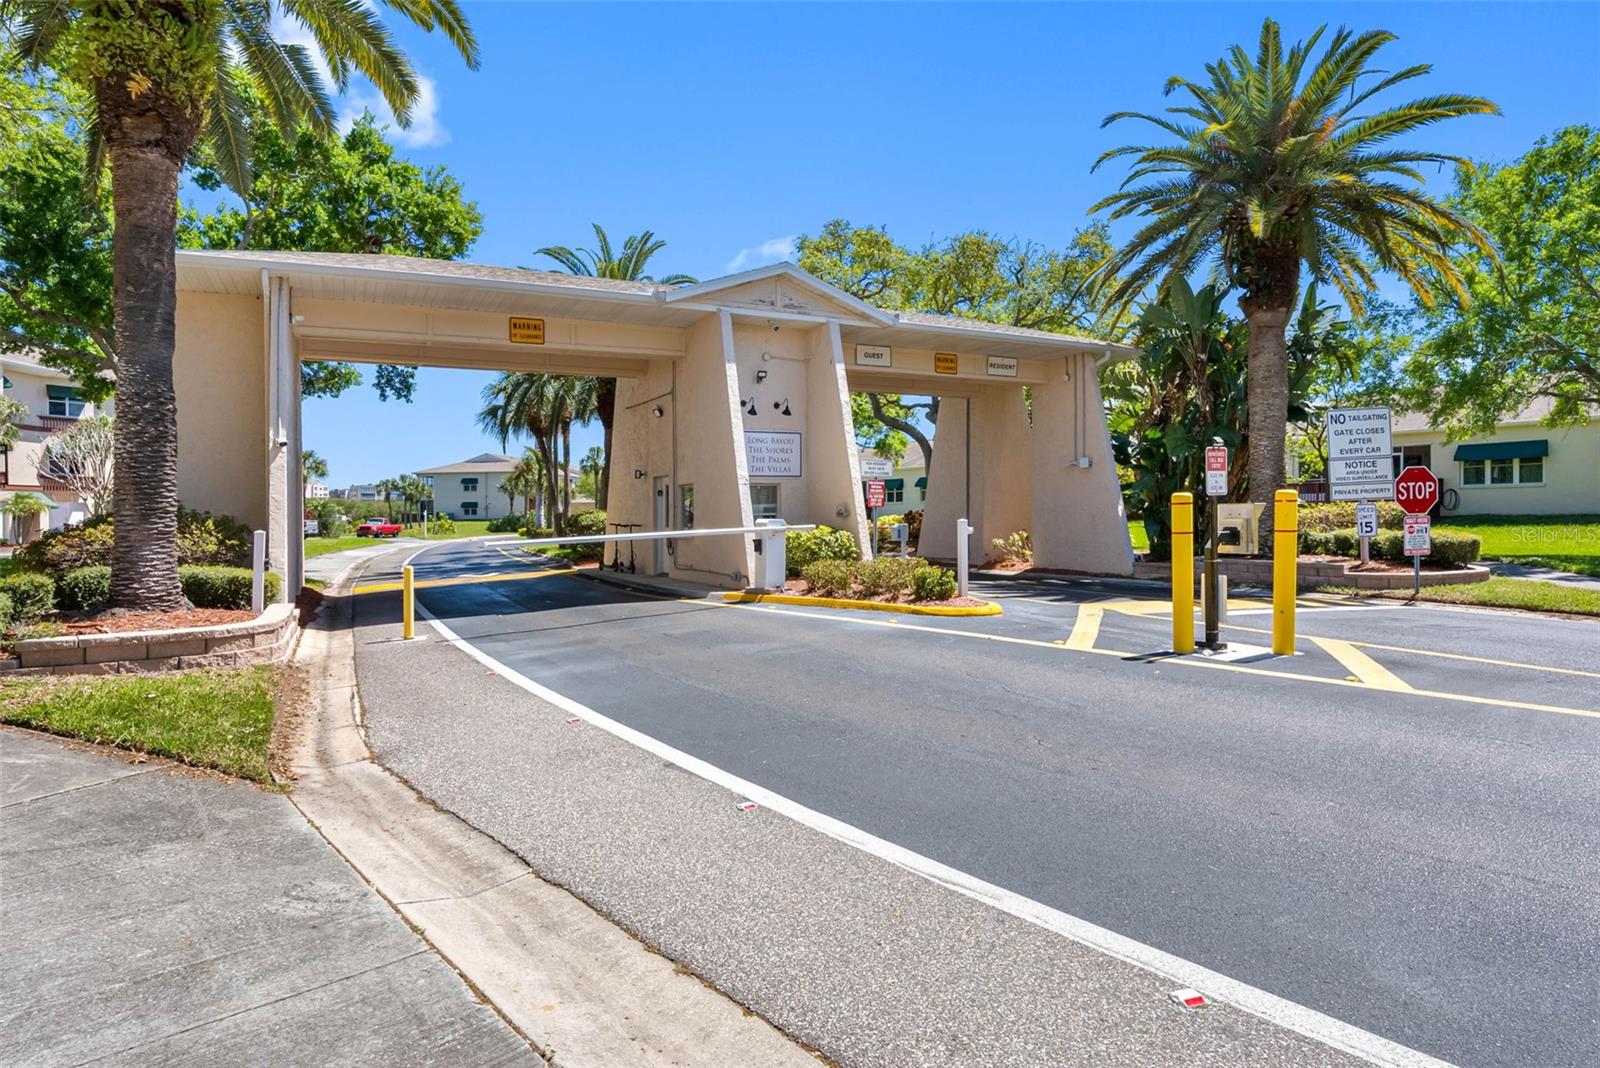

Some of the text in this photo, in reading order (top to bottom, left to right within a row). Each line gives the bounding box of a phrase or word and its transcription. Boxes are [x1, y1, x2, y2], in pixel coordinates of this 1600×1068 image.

[512, 322, 542, 331] WARNING
[1330, 413, 1388, 425] NO TAILGATING
[1355, 427, 1385, 436] CLOSES
[747, 436, 769, 444] LONG
[1349, 437, 1372, 445] AFTER
[749, 446, 794, 455] THE SHORES
[1340, 446, 1382, 456] EVERY CAR
[751, 455, 791, 463] THE PALMS
[751, 465, 792, 473] THE VILLAS
[1345, 460, 1378, 469] NOTICE
[1360, 487, 1391, 495] PROPERTY
[1398, 481, 1435, 500] STOP
[1359, 521, 1374, 534] 15
